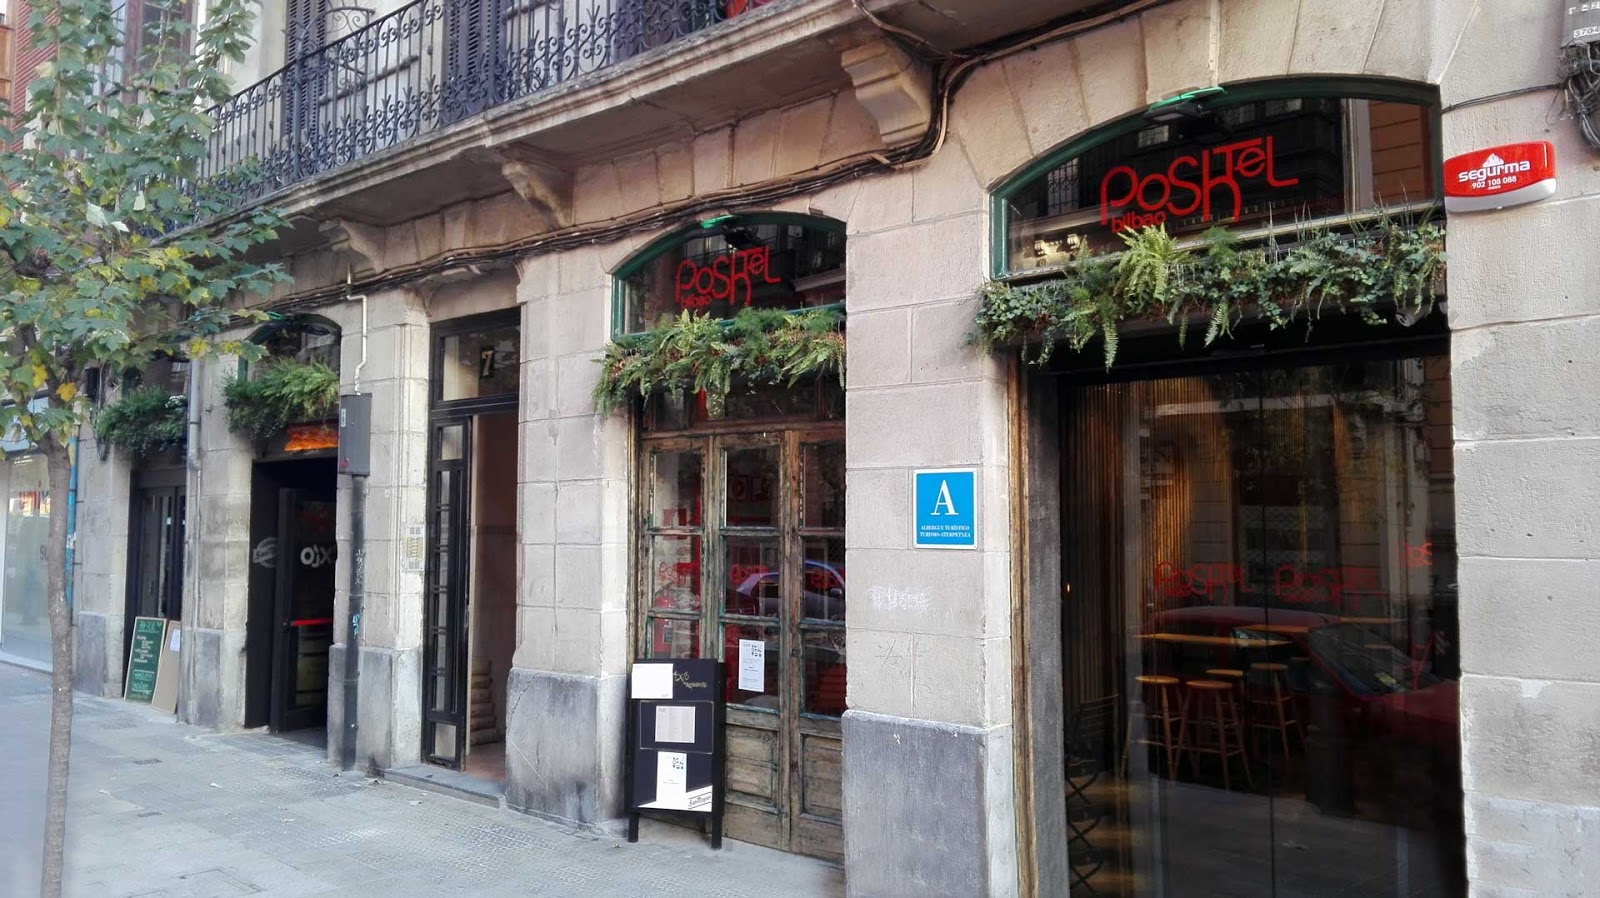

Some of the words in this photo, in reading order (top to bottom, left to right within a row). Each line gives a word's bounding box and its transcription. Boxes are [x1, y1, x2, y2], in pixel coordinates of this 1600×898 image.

[1458, 160, 1531, 183] segurma
[1471, 181, 1486, 190] 902
[1487, 178, 1501, 186] 108
[1502, 175, 1517, 184] 088
[1111, 210, 1166, 233] bilbao
[481, 350, 494, 376] 7
[930, 479, 959, 516] A
